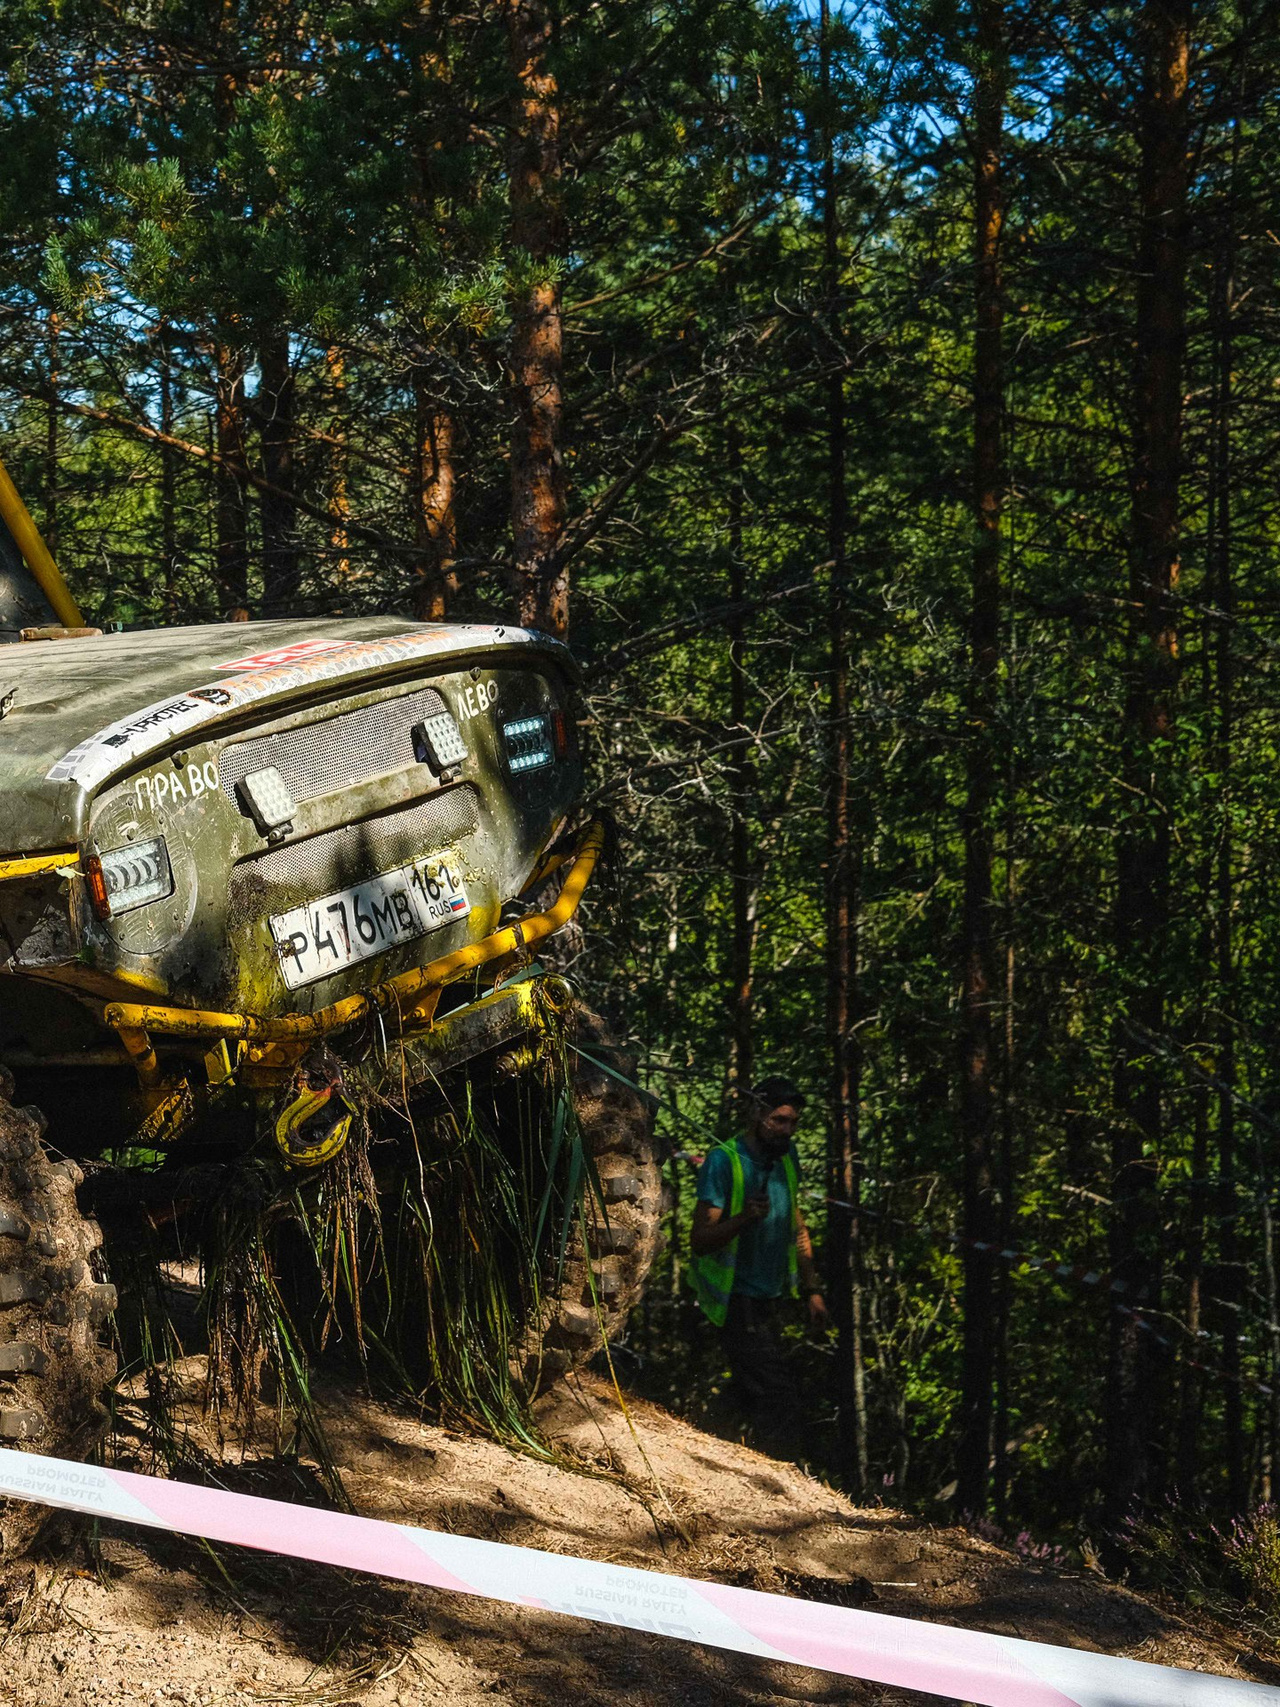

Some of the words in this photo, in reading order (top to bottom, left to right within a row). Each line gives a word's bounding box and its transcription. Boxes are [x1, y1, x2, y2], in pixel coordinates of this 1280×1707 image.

[458, 680, 498, 720] ЛЕВО
[411, 864, 456, 904] 161
[429, 901, 451, 919] RUS
